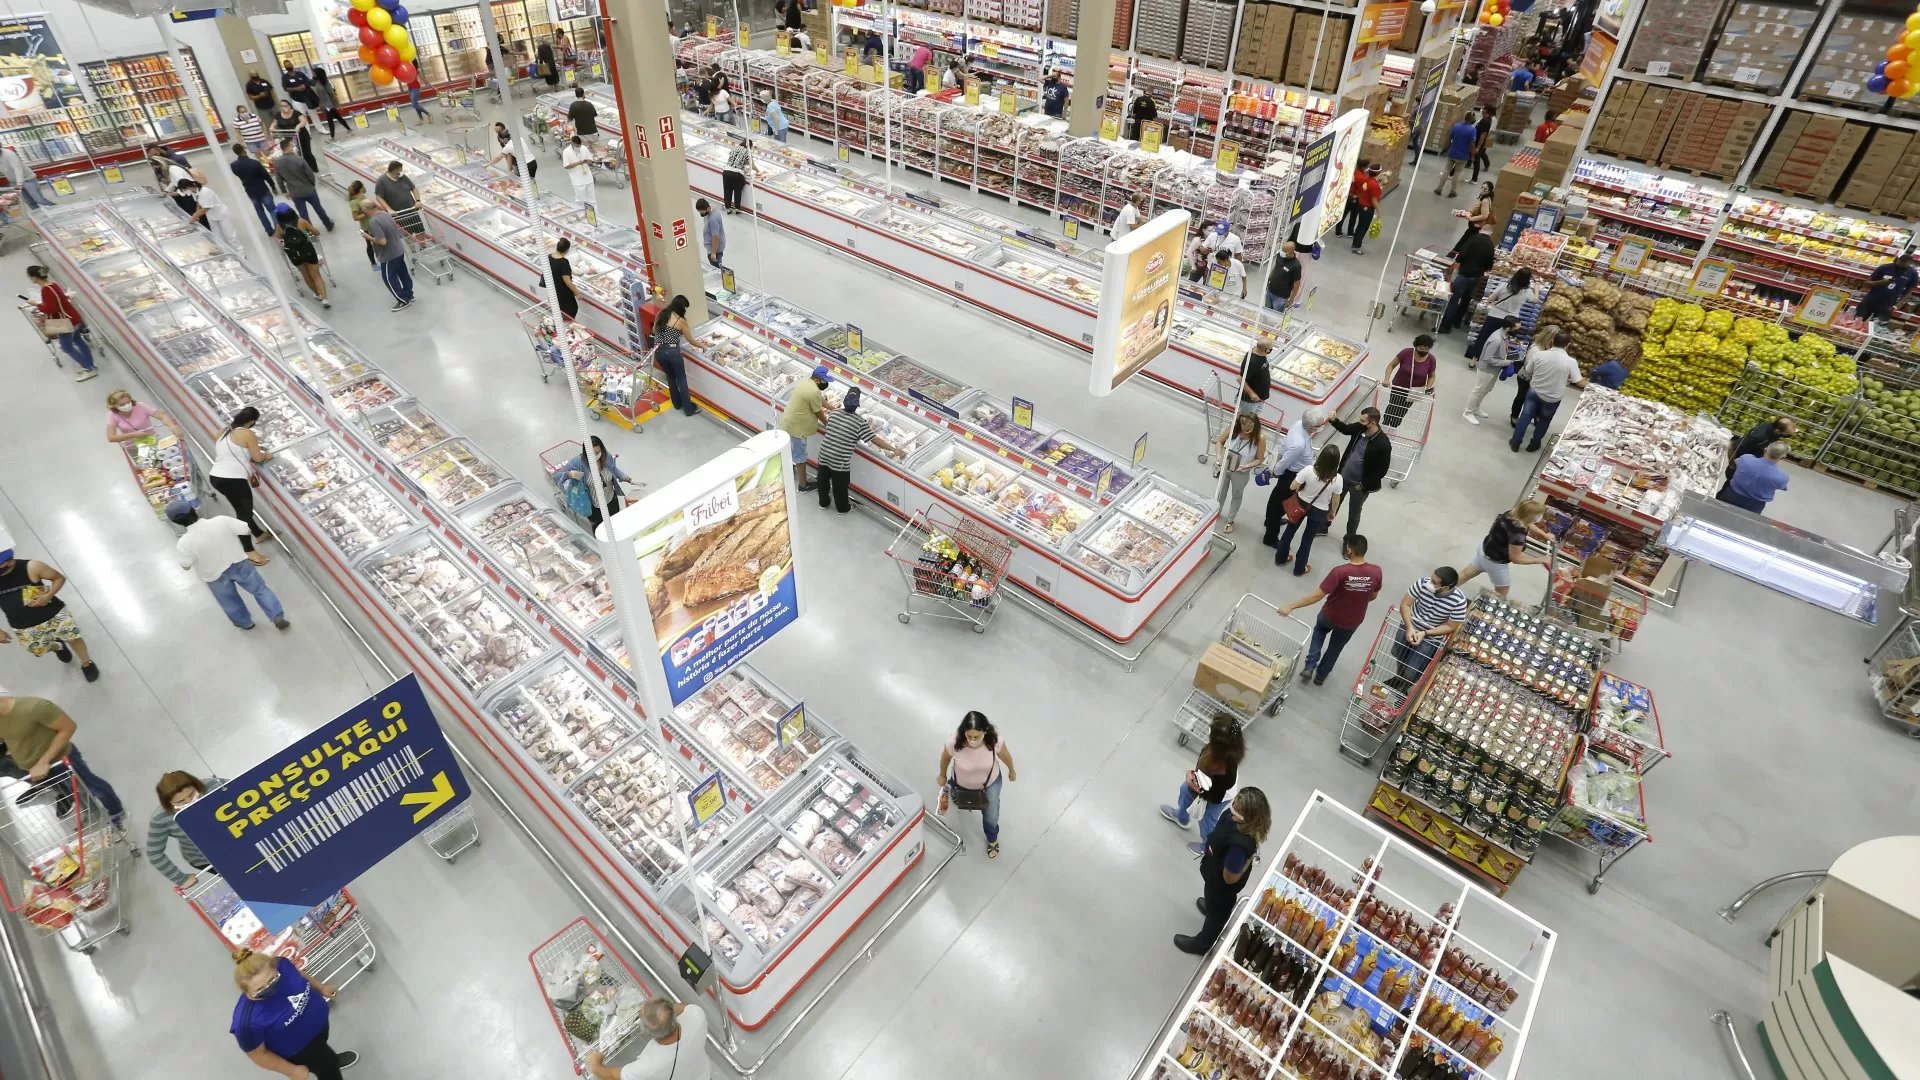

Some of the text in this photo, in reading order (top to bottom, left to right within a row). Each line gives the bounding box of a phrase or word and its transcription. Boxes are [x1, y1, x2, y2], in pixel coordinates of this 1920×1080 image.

[1621, 257, 1638, 266] 11,50
[1698, 280, 1718, 290] 22,95
[1809, 309, 1826, 318] 6,99
[690, 492, 732, 527] Friboi
[677, 606, 790, 689] história é fazer parte da sua.
[685, 602, 782, 675] A melhor parte da nossa
[214, 701, 402, 823] CONSULTE O
[227, 718, 409, 839] PREÇO AQUI
